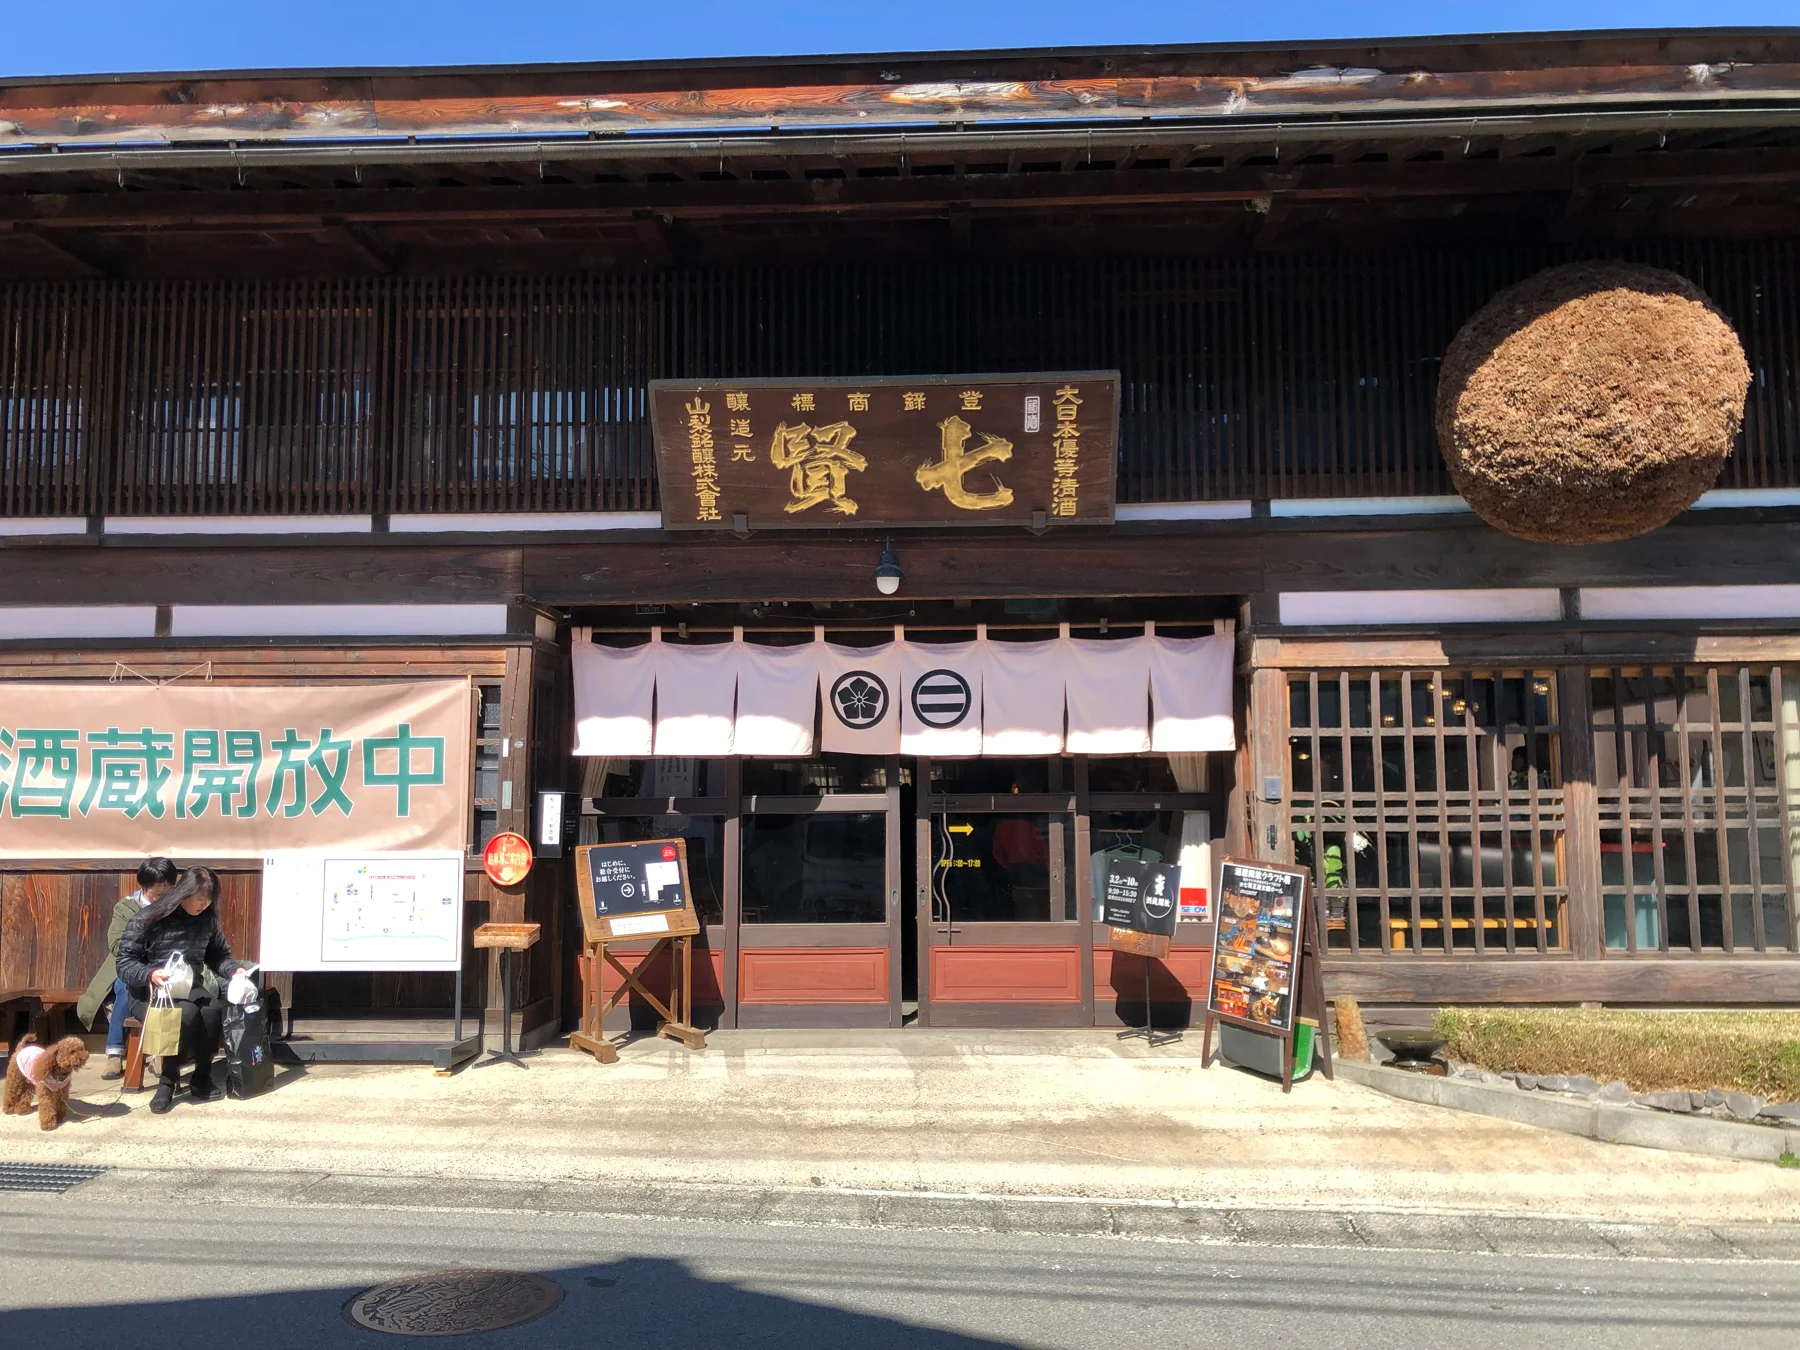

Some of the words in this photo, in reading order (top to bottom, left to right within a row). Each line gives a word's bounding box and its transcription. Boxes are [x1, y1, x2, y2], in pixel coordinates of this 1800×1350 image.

[1052, 385, 1083, 516] 大日本優等清酒
[0, 722, 447, 820] 酒蔵開放中
[502, 837, 518, 852] P
[599, 866, 631, 875] 総合受付に
[601, 860, 627, 868] はじめに、
